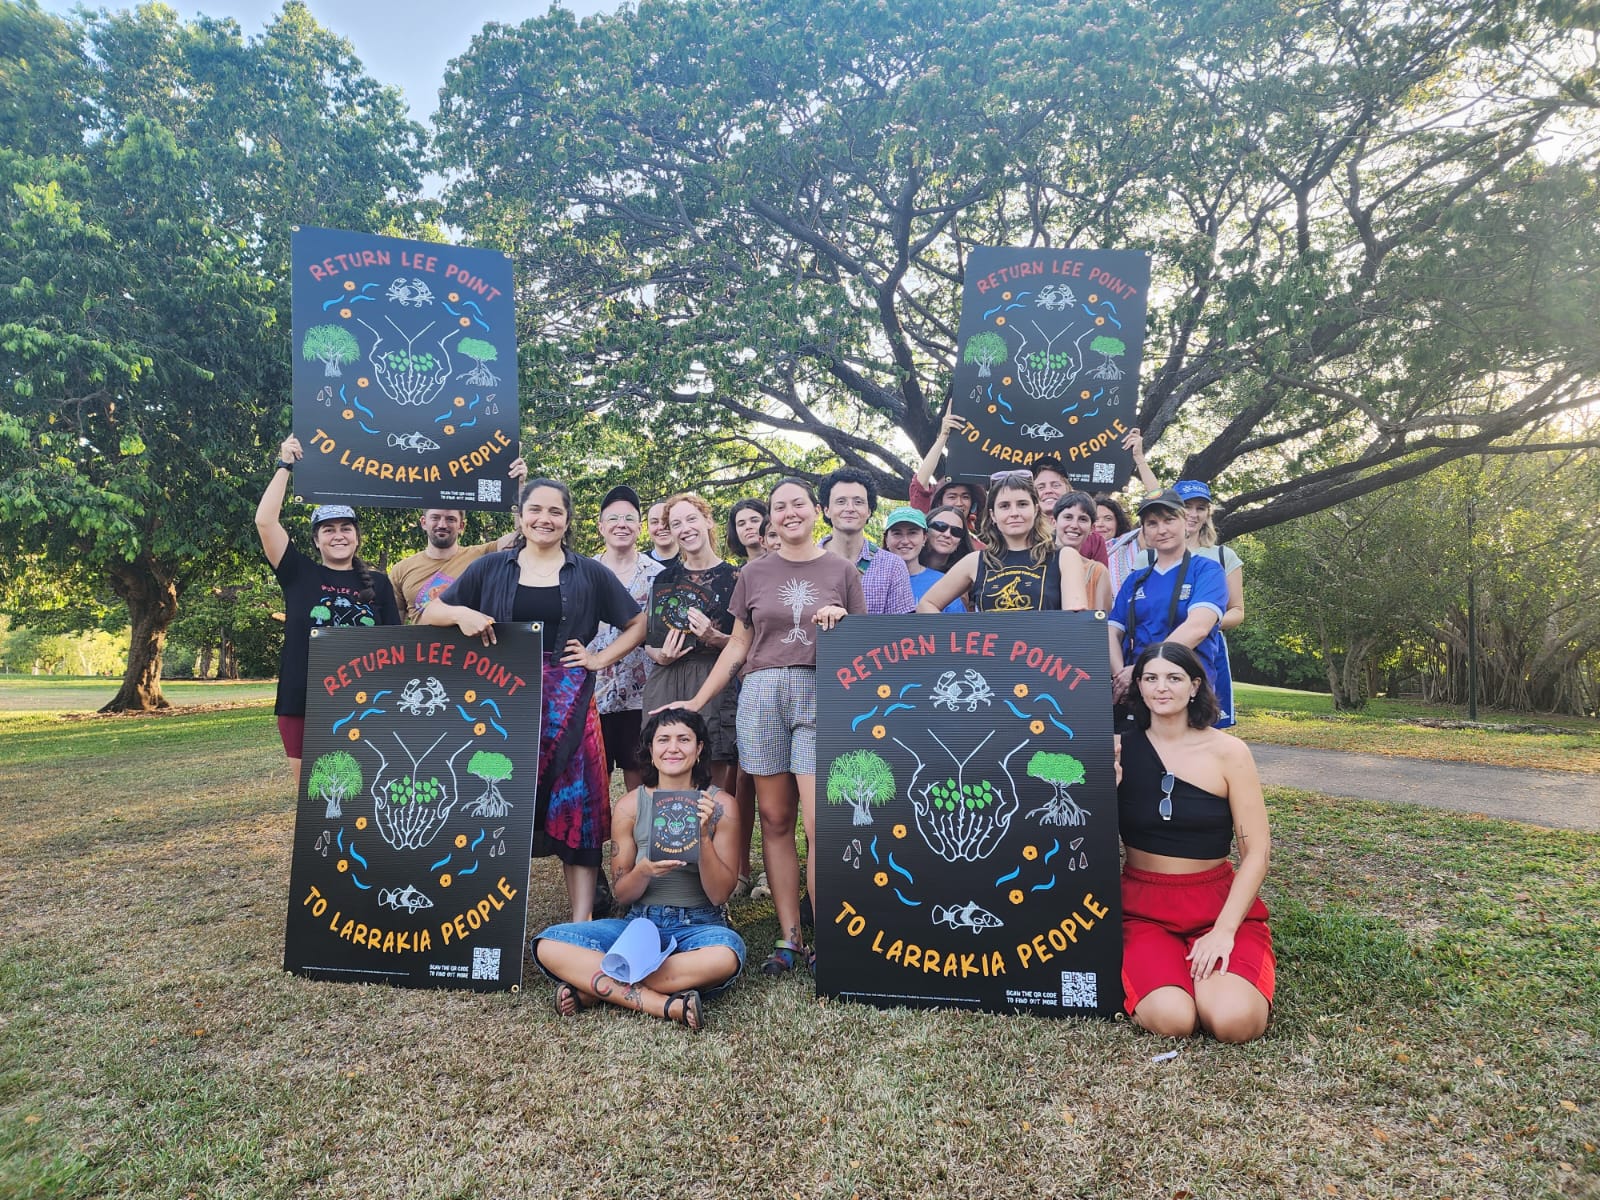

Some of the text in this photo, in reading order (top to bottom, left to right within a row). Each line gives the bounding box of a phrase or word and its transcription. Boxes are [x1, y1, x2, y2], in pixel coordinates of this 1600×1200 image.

[308, 250, 502, 301] RETURN LEE POINT
[976, 260, 1137, 300] RETURN LEE POINT
[310, 429, 512, 482] TO LARRAKIA PEOPLE
[960, 421, 980, 443] TO
[1069, 418, 1128, 462] PEOPLE
[323, 643, 526, 697] RETURN LEE POINT
[836, 631, 1091, 691] RETURN LEE POINT
[303, 876, 517, 954] TO LARRAKIA PEOPLE
[834, 892, 1109, 978] TO LARRAKIA PEOPLE
